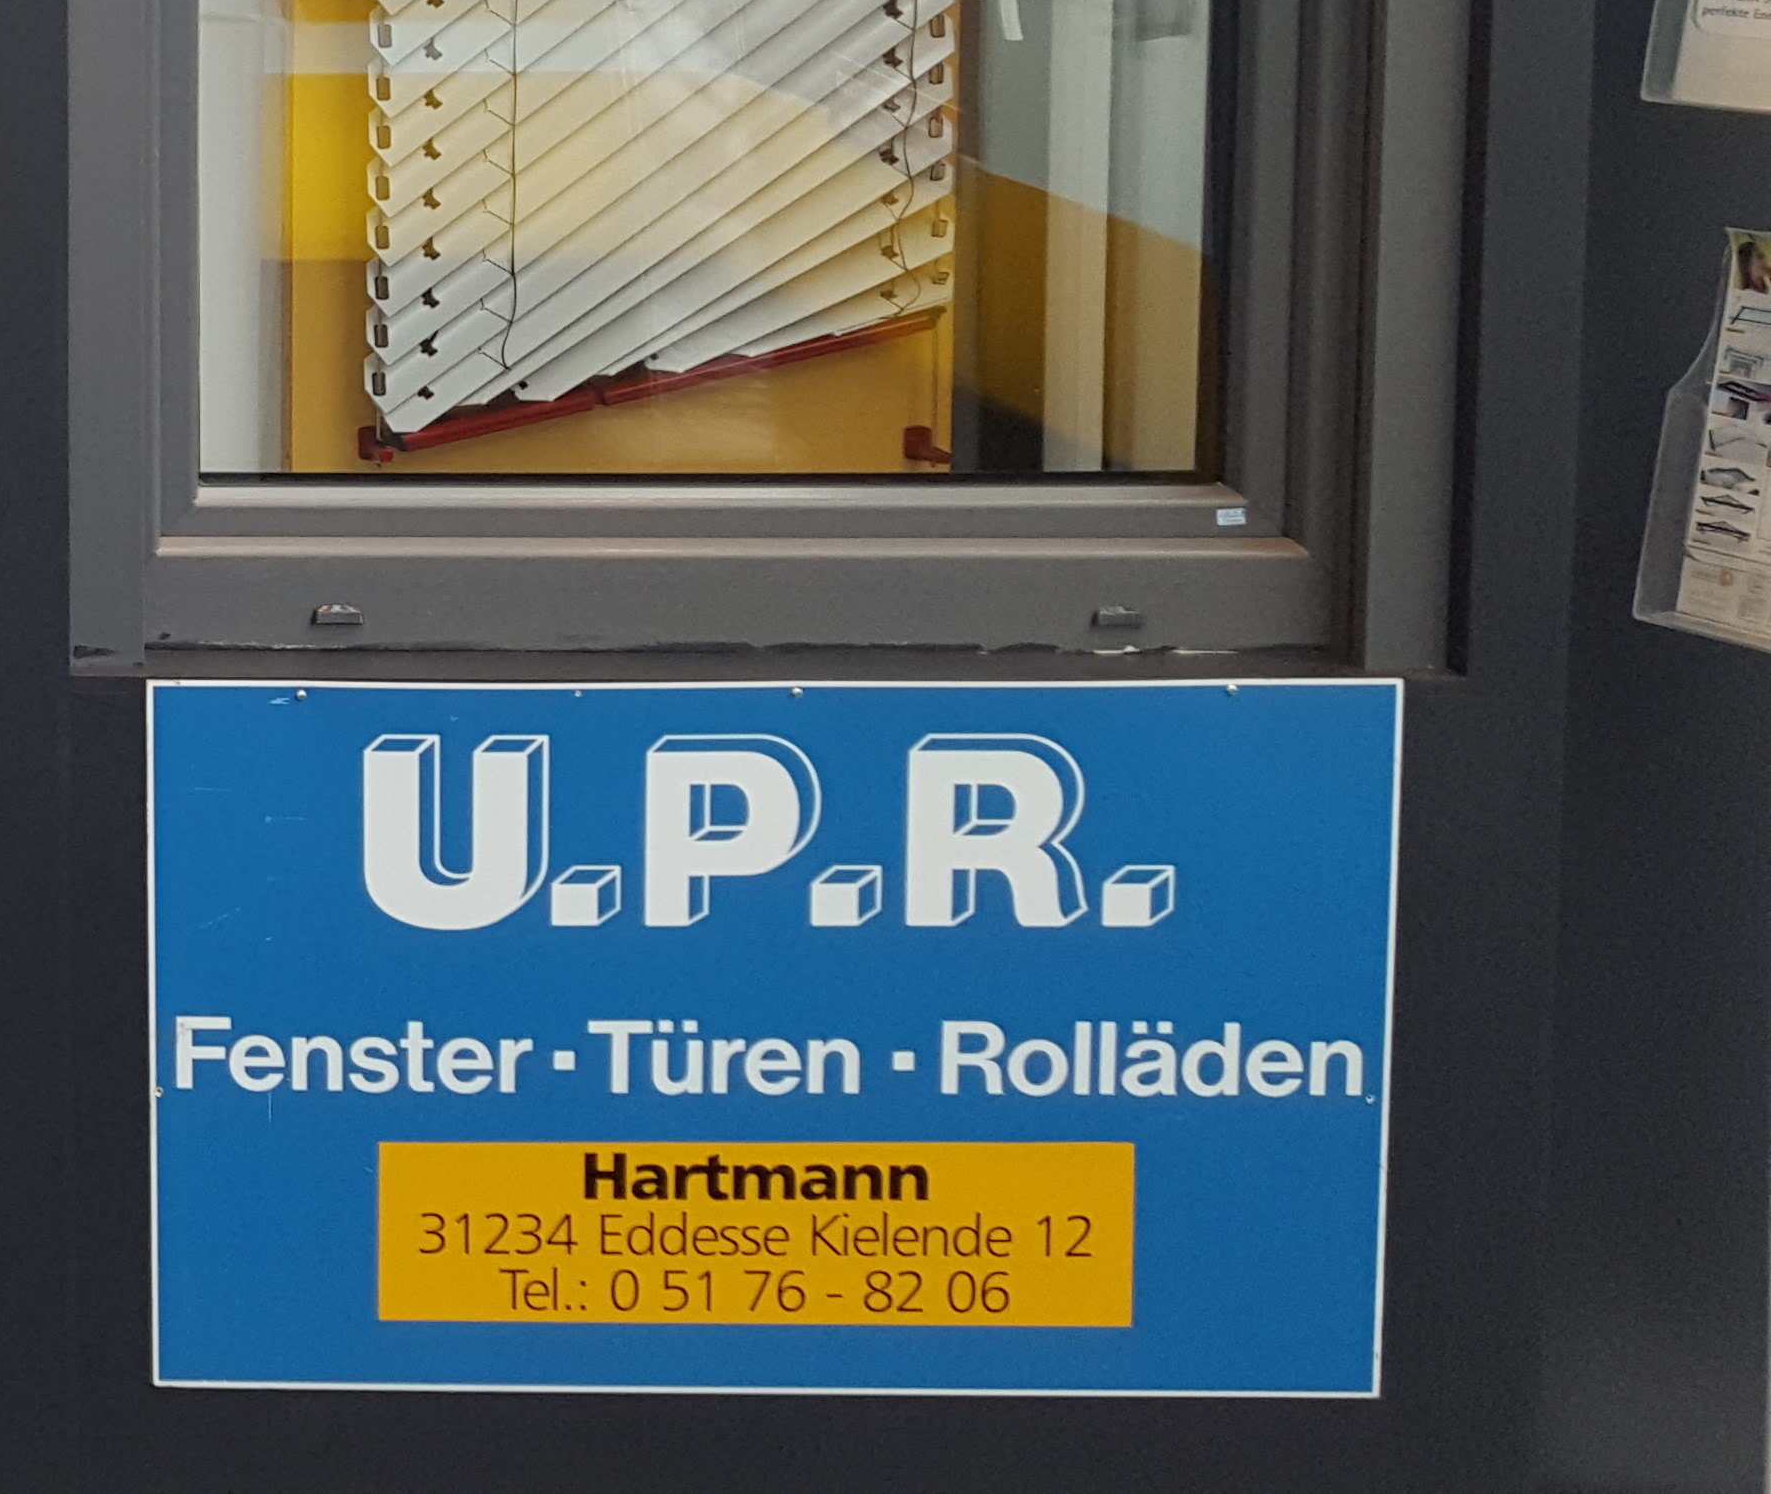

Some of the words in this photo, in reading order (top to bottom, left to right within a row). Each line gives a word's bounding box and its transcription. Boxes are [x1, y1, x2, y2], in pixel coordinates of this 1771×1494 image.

[364, 734, 1174, 930] U.P.R.
[173, 1014, 533, 1095] Fenster
[588, 1020, 859, 1095] Türen
[938, 1019, 1366, 1099] Rolläden
[585, 1153, 928, 1200] Hartmann
[420, 1213, 576, 1254] 31234
[601, 1212, 788, 1255] Eddesse
[813, 1213, 1011, 1257] Kielende
[1039, 1216, 1091, 1256] 12
[500, 1268, 585, 1310] Tel.:
[612, 1270, 638, 1311] 0
[664, 1271, 710, 1311] 51
[746, 1271, 804, 1311] 76
[865, 1271, 922, 1312] 82
[948, 1271, 1008, 1313] 06
